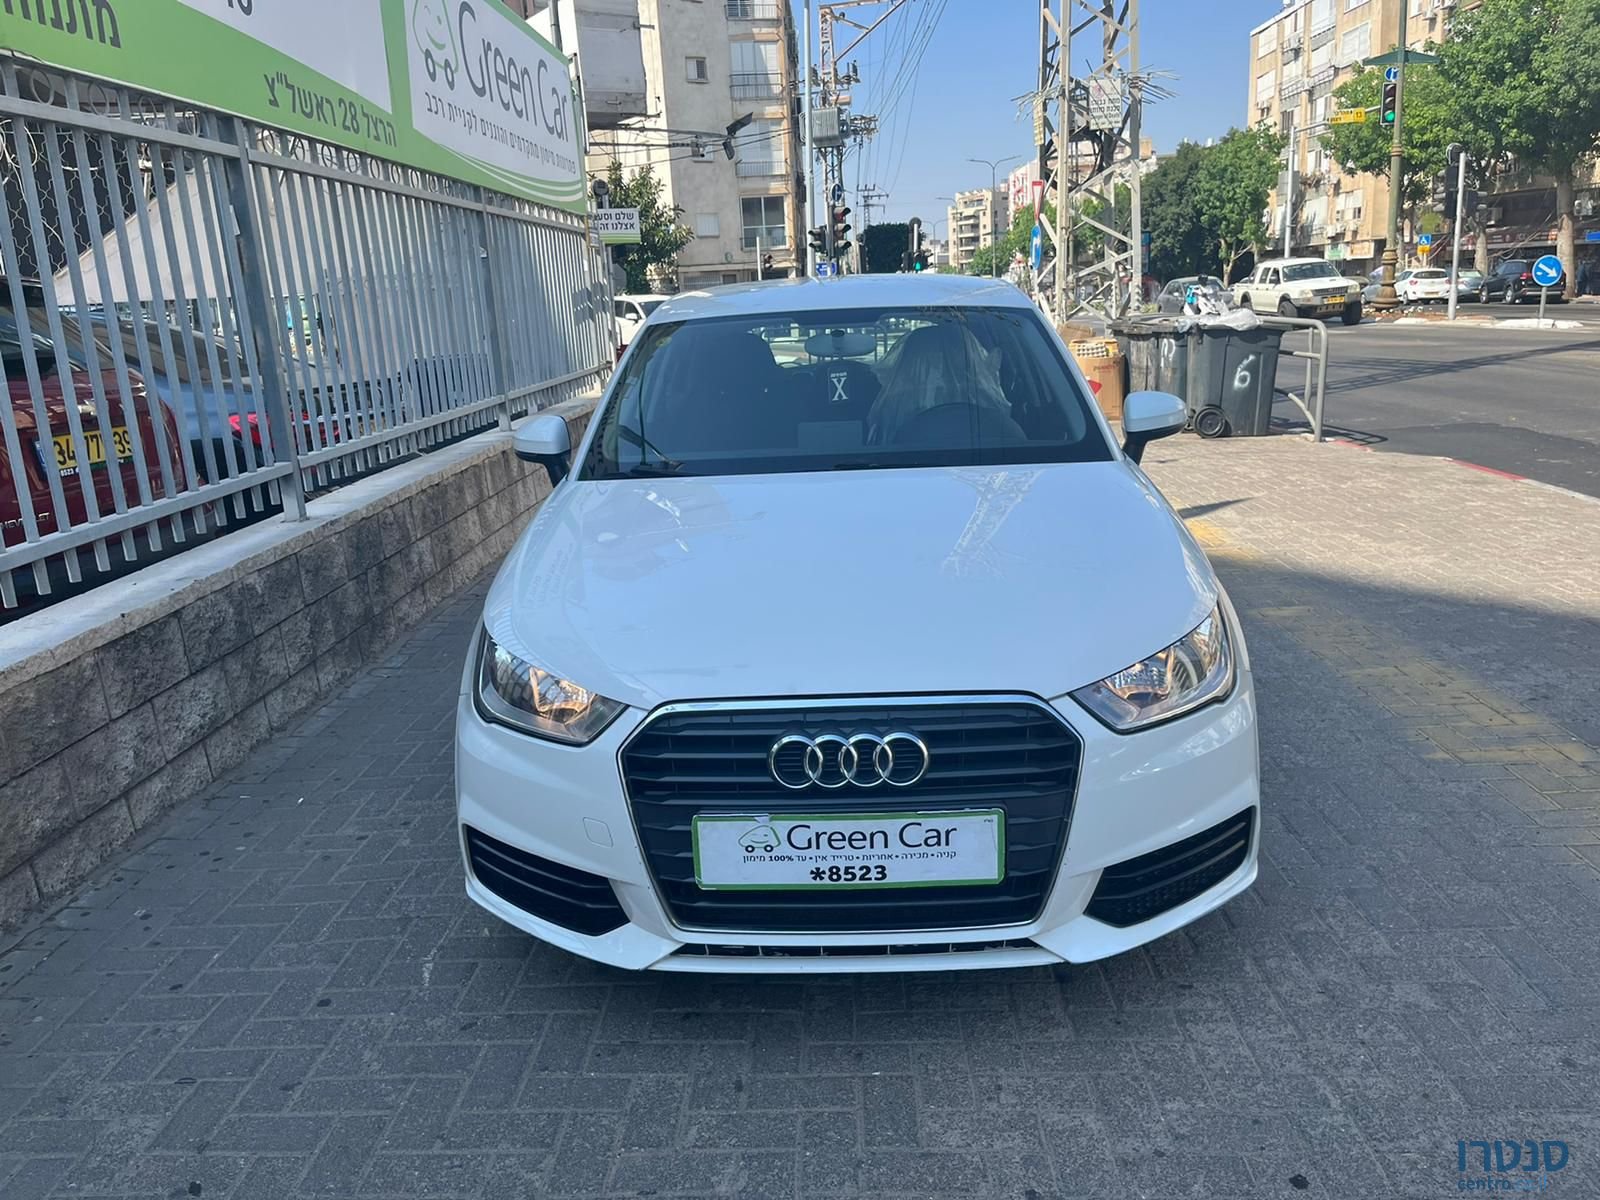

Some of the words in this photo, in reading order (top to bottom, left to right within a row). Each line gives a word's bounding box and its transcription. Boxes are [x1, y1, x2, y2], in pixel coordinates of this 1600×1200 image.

[458, 1, 538, 127] Green
[537, 58, 568, 143] Car
[425, 91, 446, 118] רכב
[338, 97, 360, 134] 28
[447, 102, 478, 136] לקניית
[360, 103, 397, 147] הרצל
[614, 211, 634, 220] שלם
[599, 222, 610, 231] זה
[610, 221, 635, 230] אצלנו
[1233, 354, 1256, 390] 6
[787, 824, 889, 850] Green
[899, 821, 958, 849] Car
[743, 855, 766, 863] מימון
[814, 855, 828, 863] אין
[831, 854, 854, 862] טרייד
[861, 853, 894, 862] אחריות
[901, 852, 929, 860] מכירה
[936, 850, 957, 860] קניה
